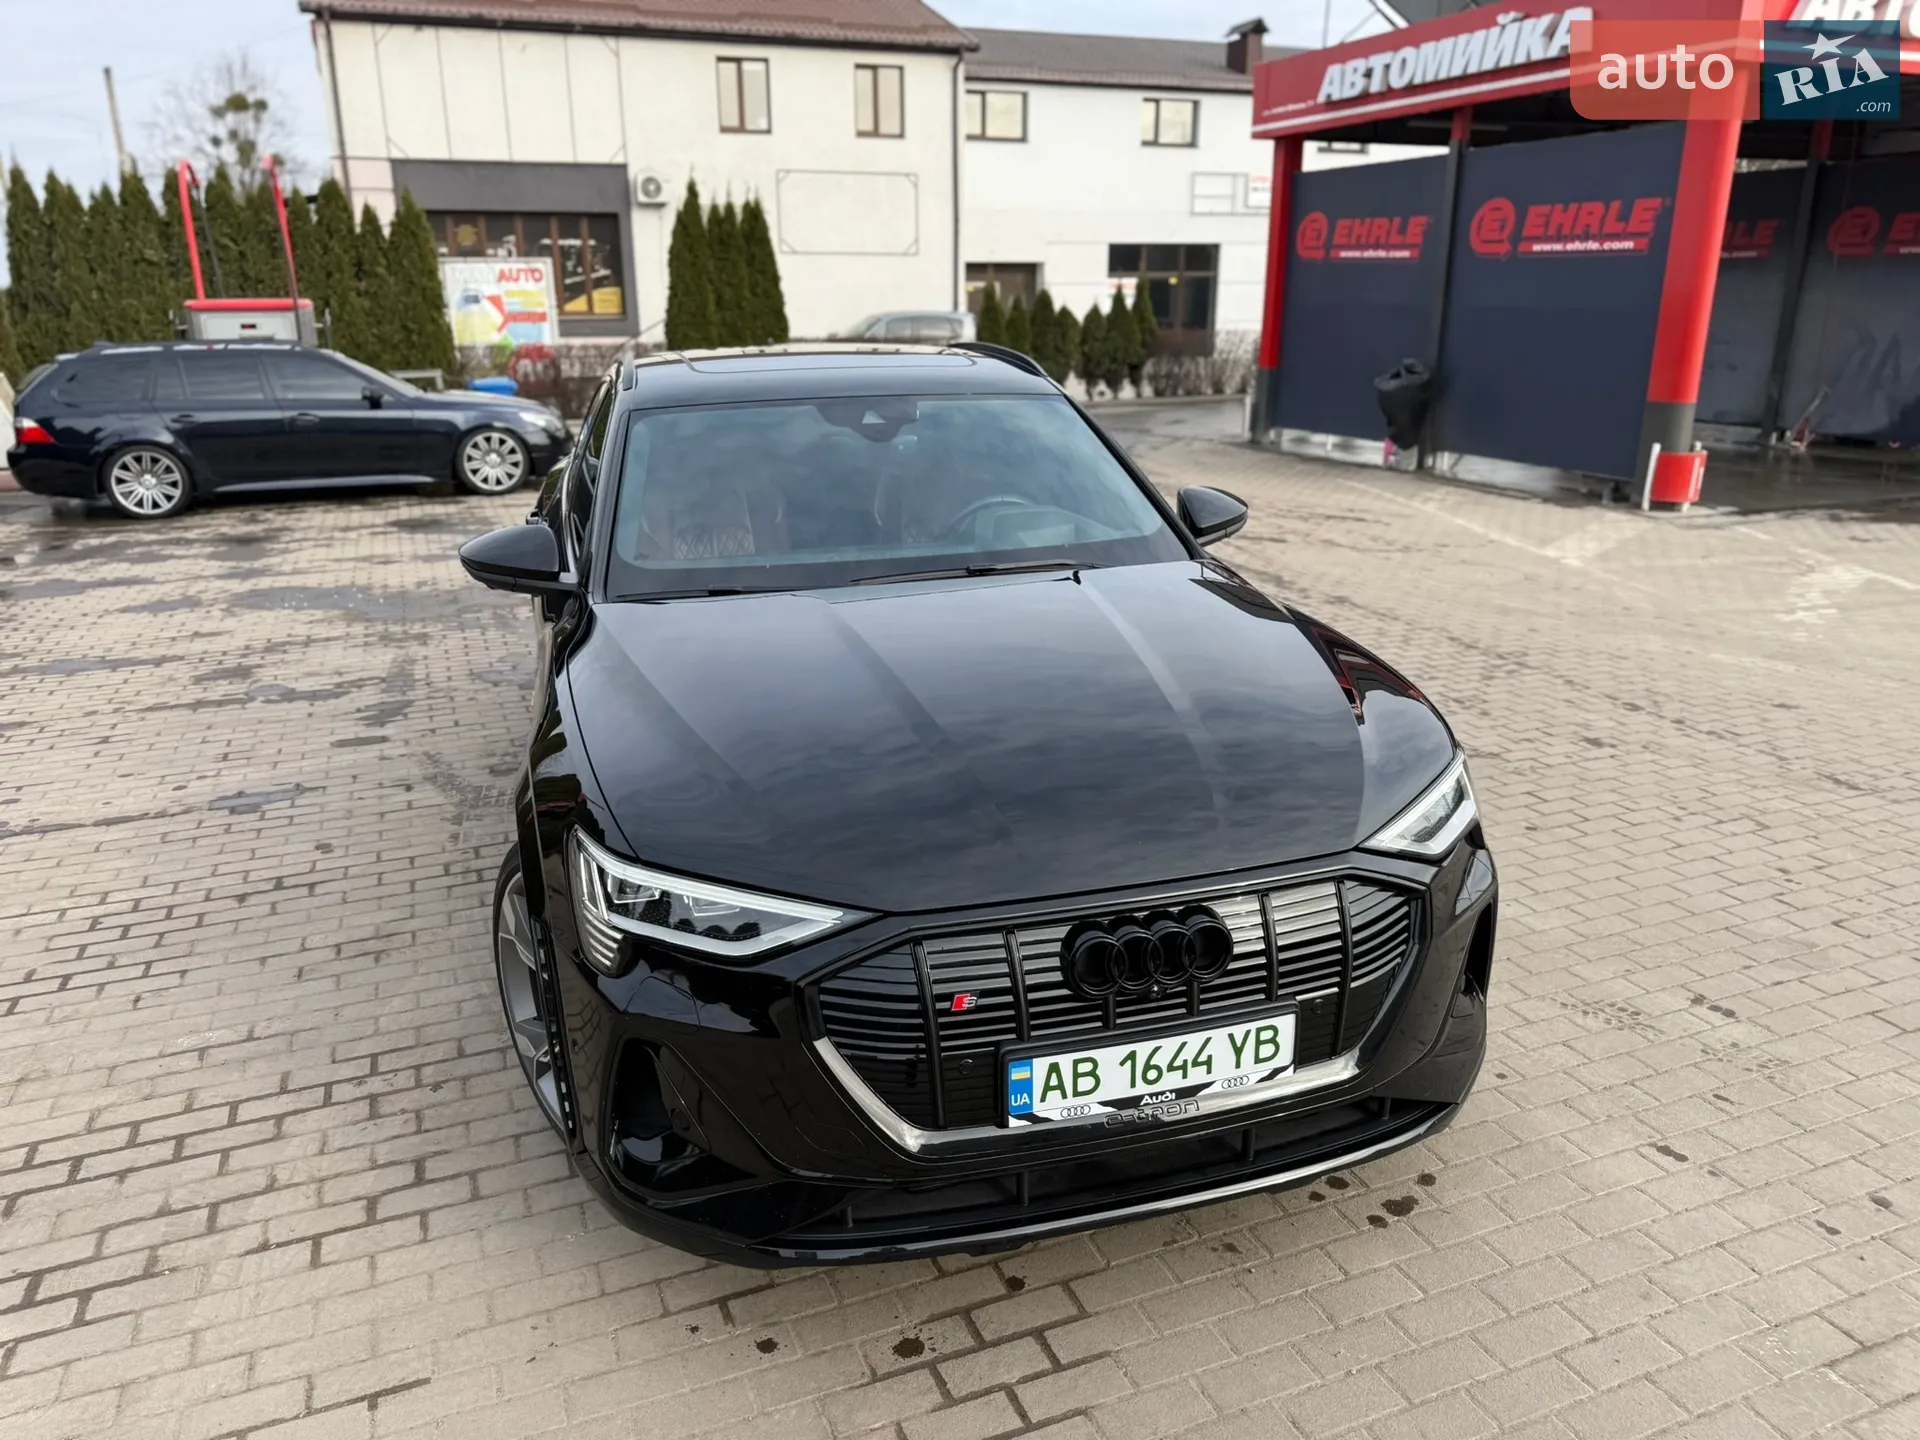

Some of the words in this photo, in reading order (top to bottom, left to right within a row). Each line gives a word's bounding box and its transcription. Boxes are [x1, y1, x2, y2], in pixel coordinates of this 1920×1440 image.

[1317, 6, 1593, 104] АВТОМИЙКА
[1332, 216, 1429, 245] EHRLE
[1521, 198, 1663, 238] EHRLE
[1532, 240, 1634, 252] www.ehrle.com
[1040, 1058, 1101, 1103] AB
[1118, 1036, 1213, 1089] 1644
[1227, 1024, 1280, 1070] YB
[1011, 1093, 1031, 1107] UA
[1140, 1091, 1176, 1106] Audi
[1103, 1099, 1200, 1129] e-tron
